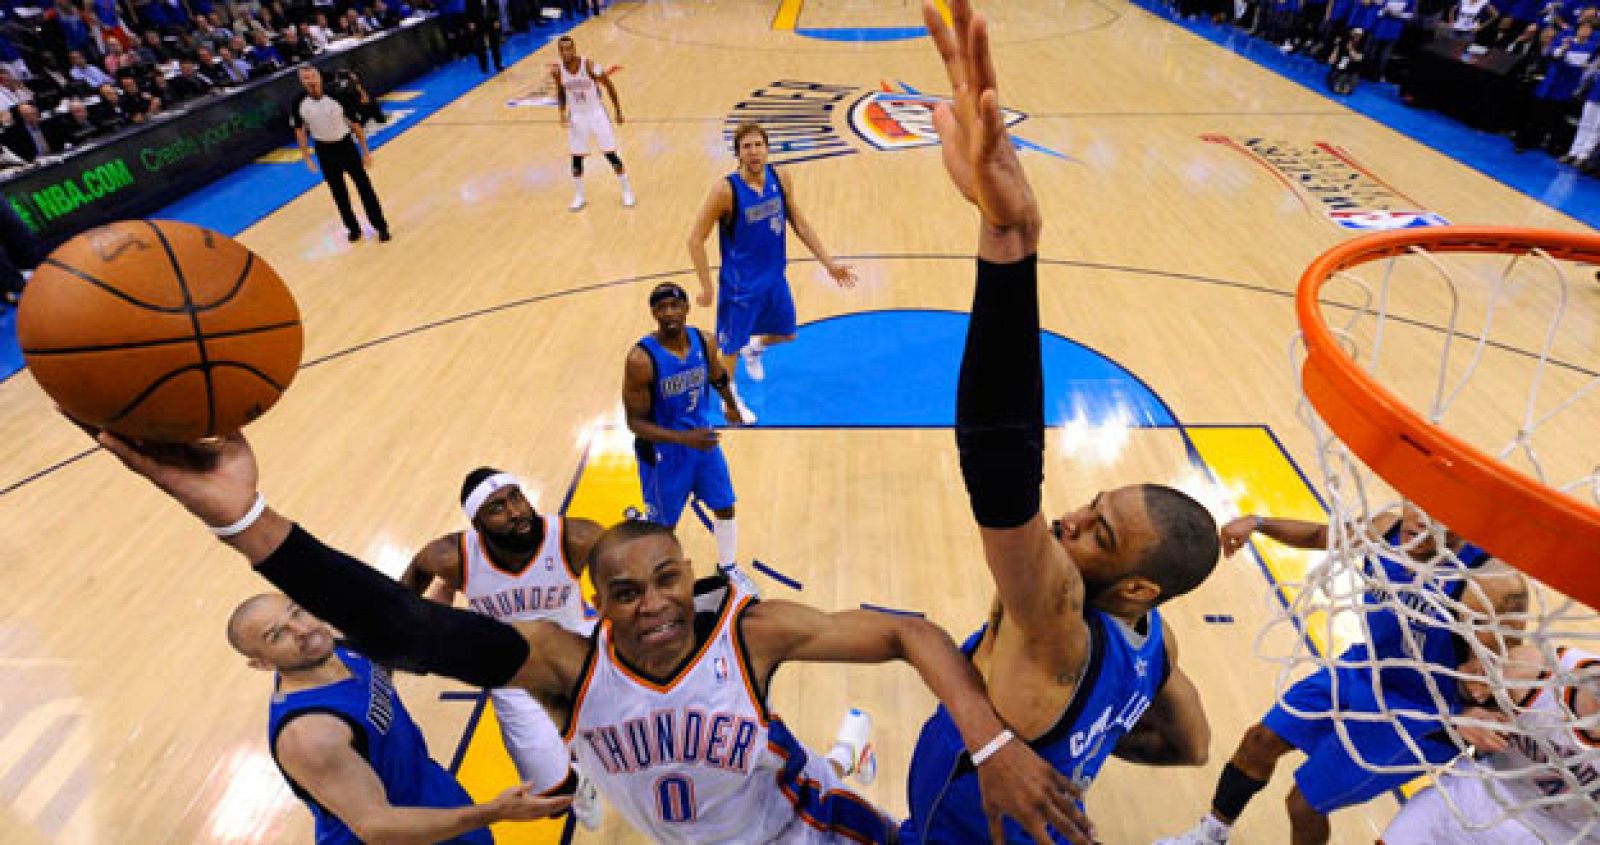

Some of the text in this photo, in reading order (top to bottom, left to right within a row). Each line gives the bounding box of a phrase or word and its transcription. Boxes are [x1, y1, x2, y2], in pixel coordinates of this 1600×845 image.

[32, 158, 135, 221] NBA.COM
[685, 389, 700, 413] 3
[468, 584, 573, 620] THUNDER
[578, 705, 759, 776] THUNDER
[652, 772, 697, 824] 0
